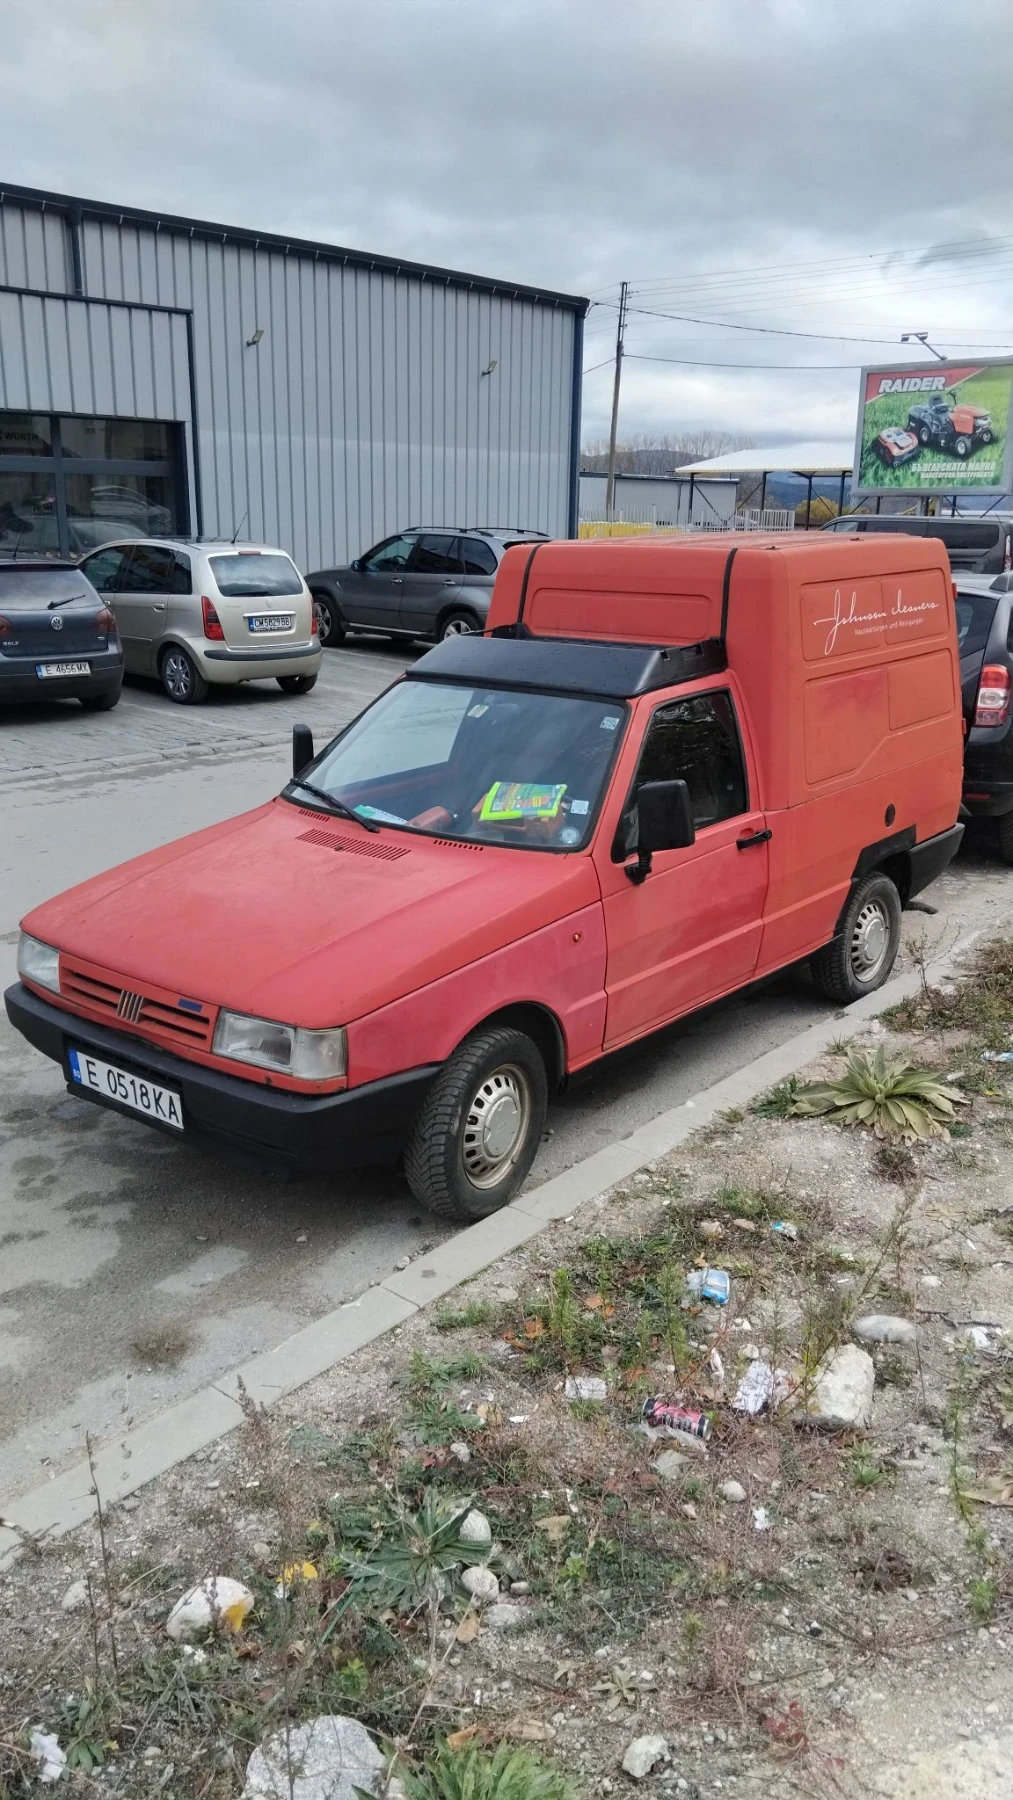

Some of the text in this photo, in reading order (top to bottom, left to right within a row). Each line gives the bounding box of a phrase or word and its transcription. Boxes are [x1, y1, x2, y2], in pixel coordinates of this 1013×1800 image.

[879, 377, 945, 393] RAIDER
[911, 462, 996, 472] БЪЛГАРСКАТА МАРКА
[813, 589, 887, 655] Johnson
[45, 666, 52, 675] E
[86, 1059, 99, 1087] E
